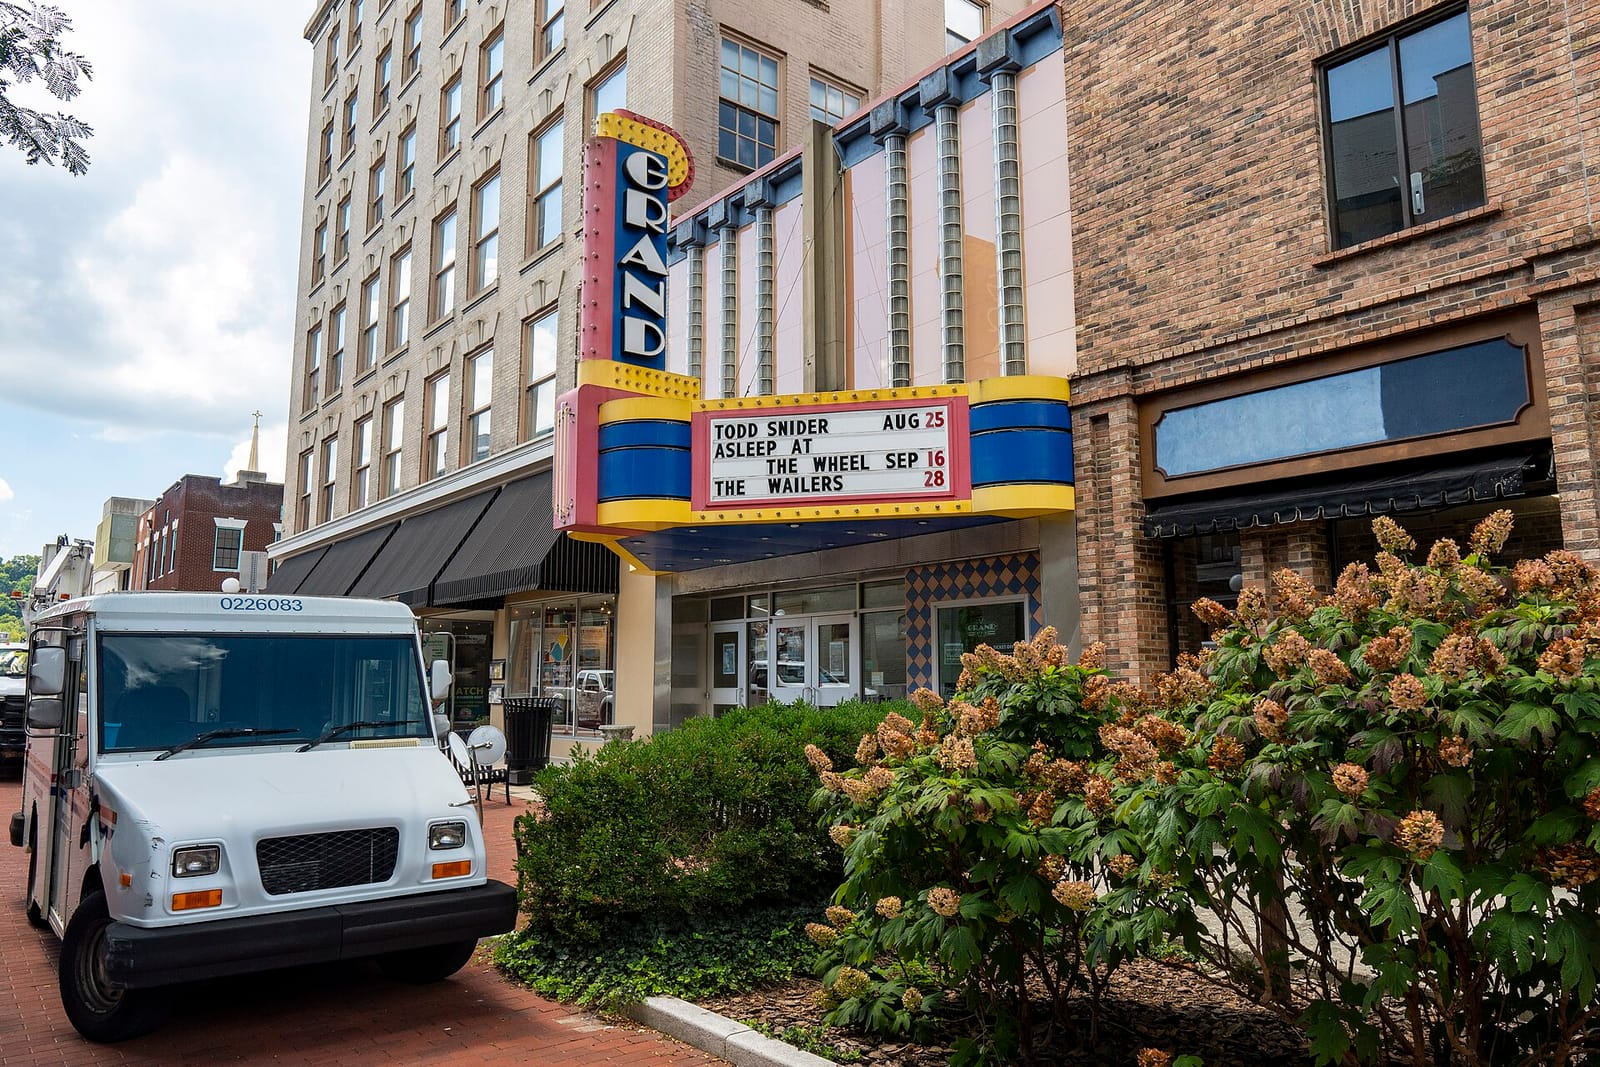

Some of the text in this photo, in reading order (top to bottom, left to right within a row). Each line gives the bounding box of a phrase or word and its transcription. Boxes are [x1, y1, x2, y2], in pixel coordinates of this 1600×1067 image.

[620, 150, 668, 356] GRAND
[715, 411, 945, 440] TODD SNIDER AUG 25
[715, 438, 813, 459] ASLEEP AT
[766, 450, 945, 474] THE WHEEL SEP 16
[715, 470, 945, 497] THE WAILERS 28
[220, 597, 303, 612] 0226083
[456, 687, 484, 695] ATCH
